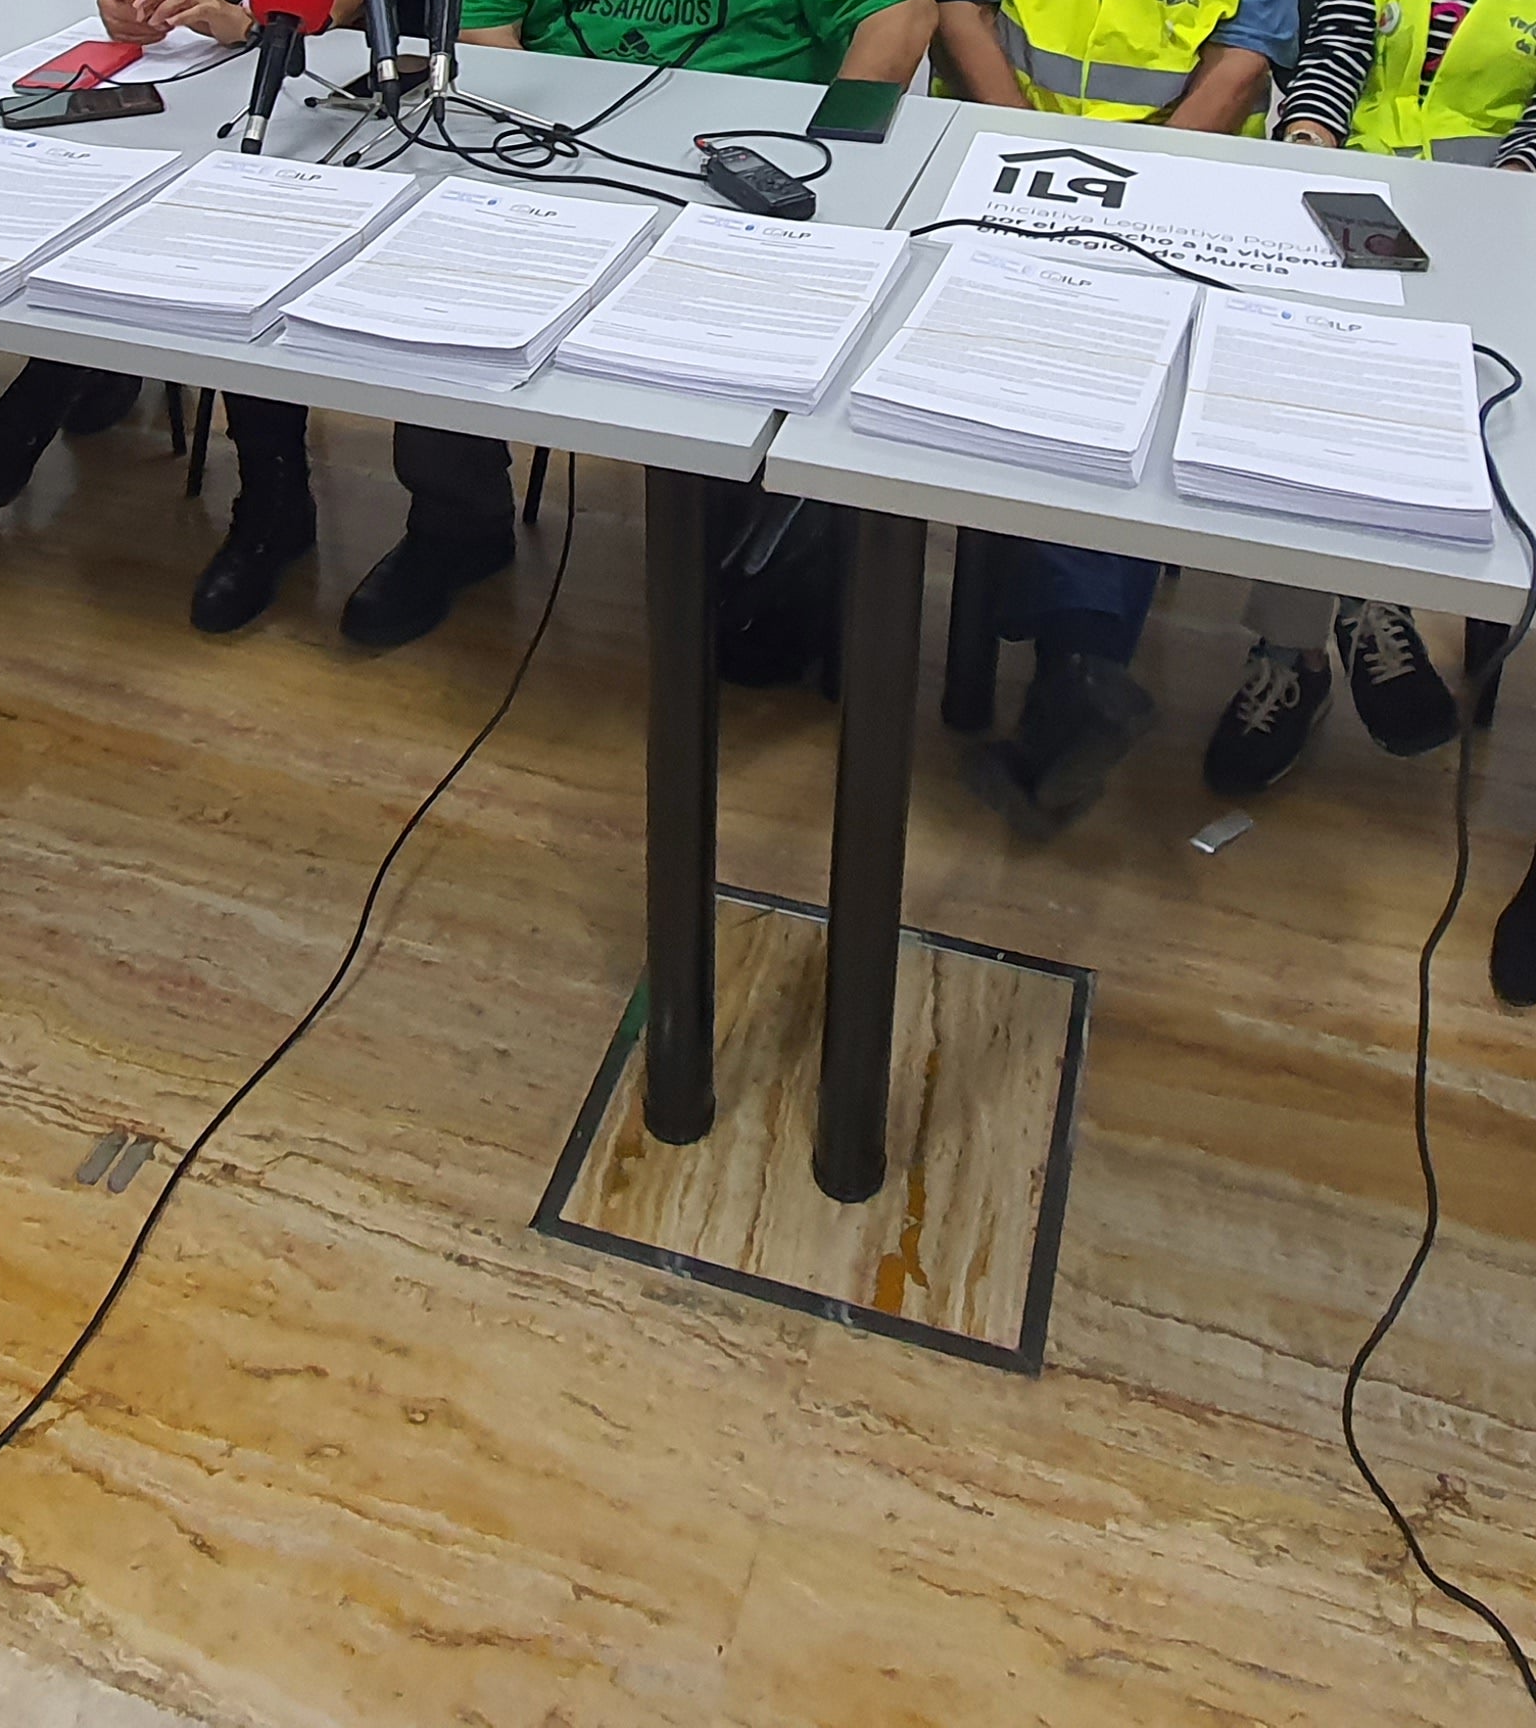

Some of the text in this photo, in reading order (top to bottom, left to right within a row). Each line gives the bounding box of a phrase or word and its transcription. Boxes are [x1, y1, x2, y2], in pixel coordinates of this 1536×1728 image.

[986, 201, 1094, 224] Iniciativa
[1244, 235, 1334, 256] Popula
[1195, 253, 1289, 276] Murcia
[1206, 238, 1228, 254] la
[1238, 246, 1339, 269] viviend
